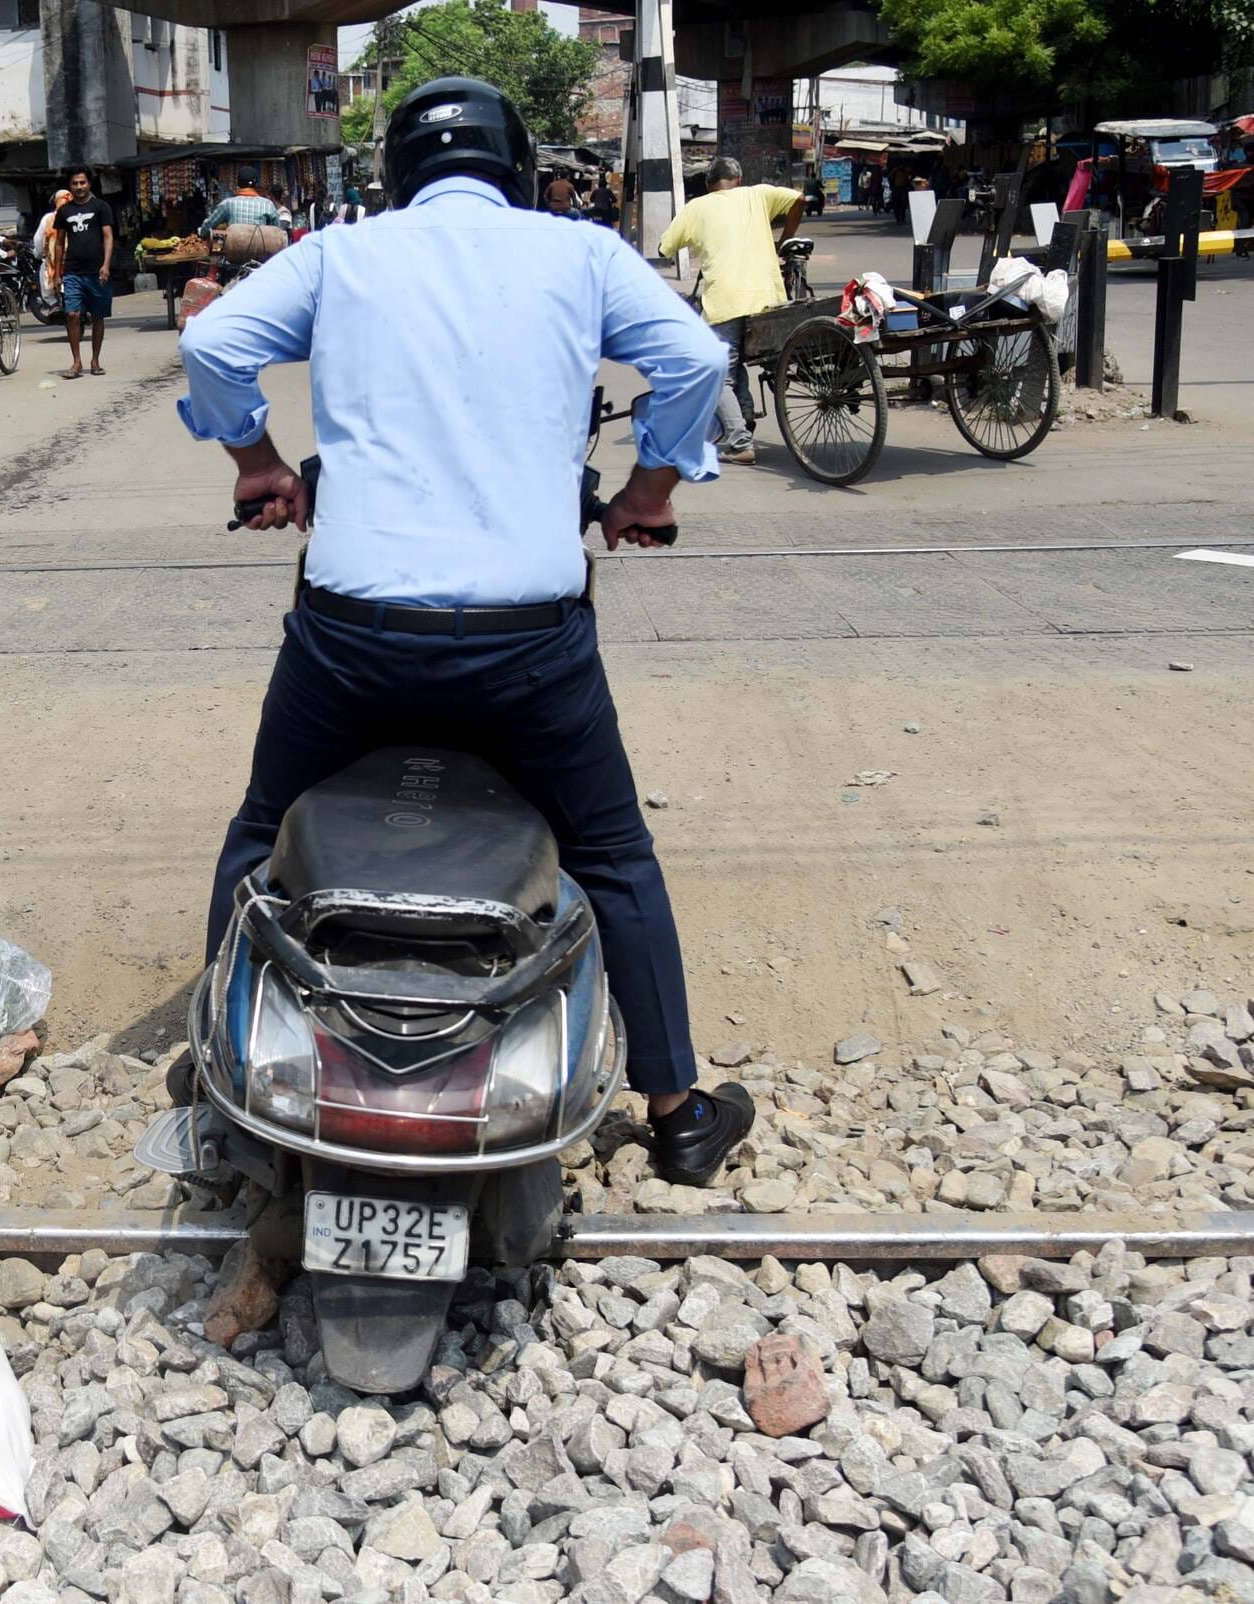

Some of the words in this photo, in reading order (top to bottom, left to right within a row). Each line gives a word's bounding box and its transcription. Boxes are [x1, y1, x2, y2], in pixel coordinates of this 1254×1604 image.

[72, 223, 89, 232] BOY
[312, 1226, 331, 1237] IND
[334, 1199, 448, 1241] UP32E
[332, 1236, 446, 1277] Z1757
